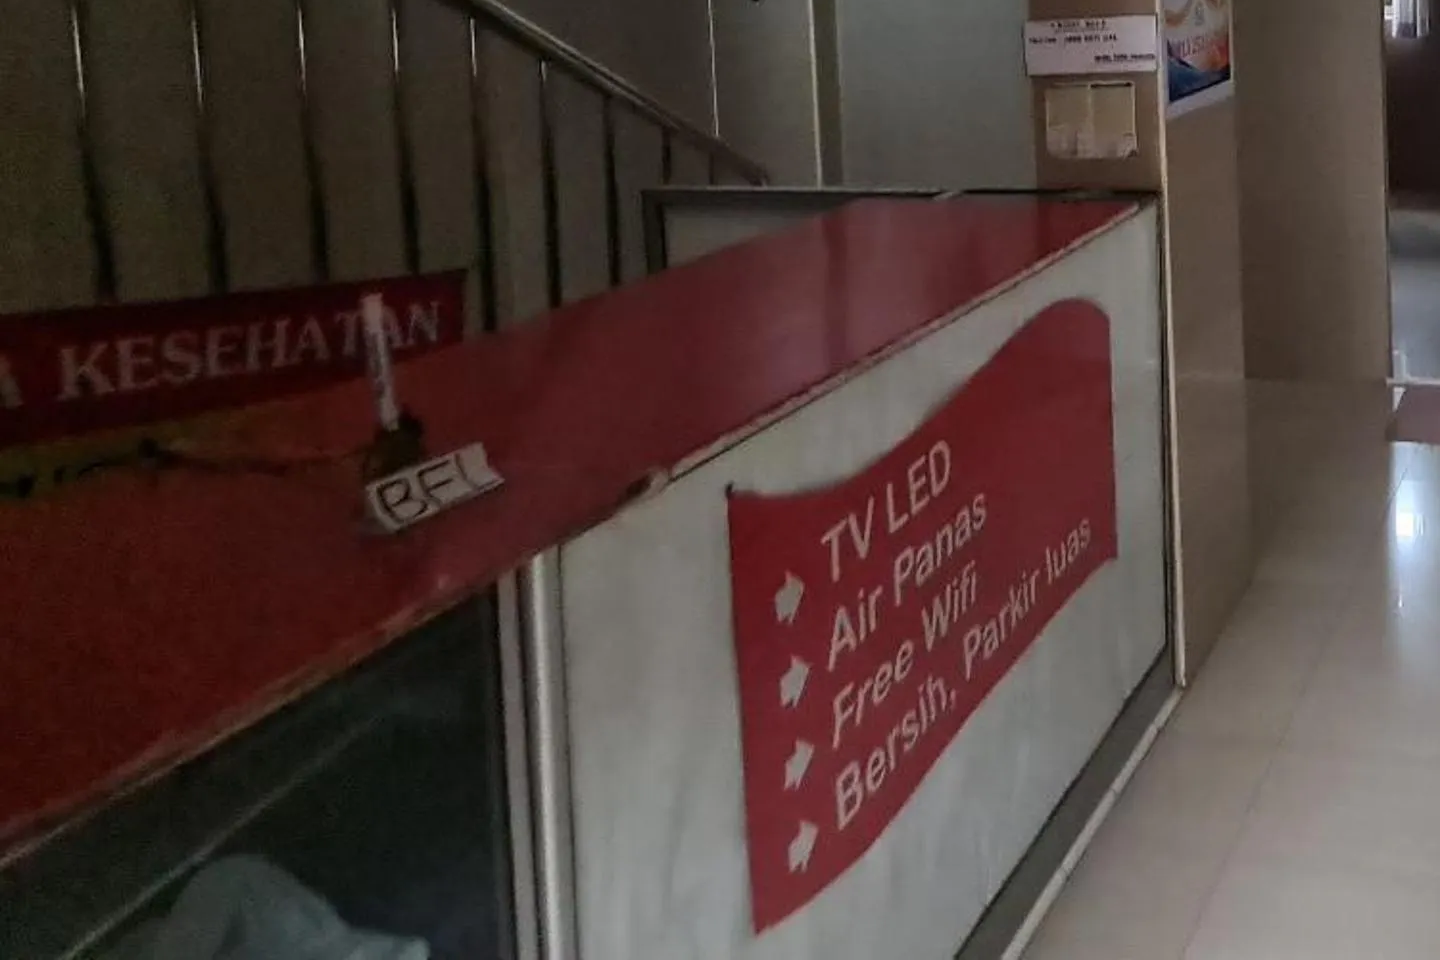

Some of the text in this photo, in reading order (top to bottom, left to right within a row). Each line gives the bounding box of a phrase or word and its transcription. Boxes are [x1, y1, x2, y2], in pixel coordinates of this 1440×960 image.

[53, 299, 441, 402] KESEHATAN
[820, 439, 952, 583] TV LED
[828, 492, 987, 673] Air Panas
[831, 559, 978, 750] Free Wifi
[834, 518, 1092, 832] Bersih, Parkir luas
